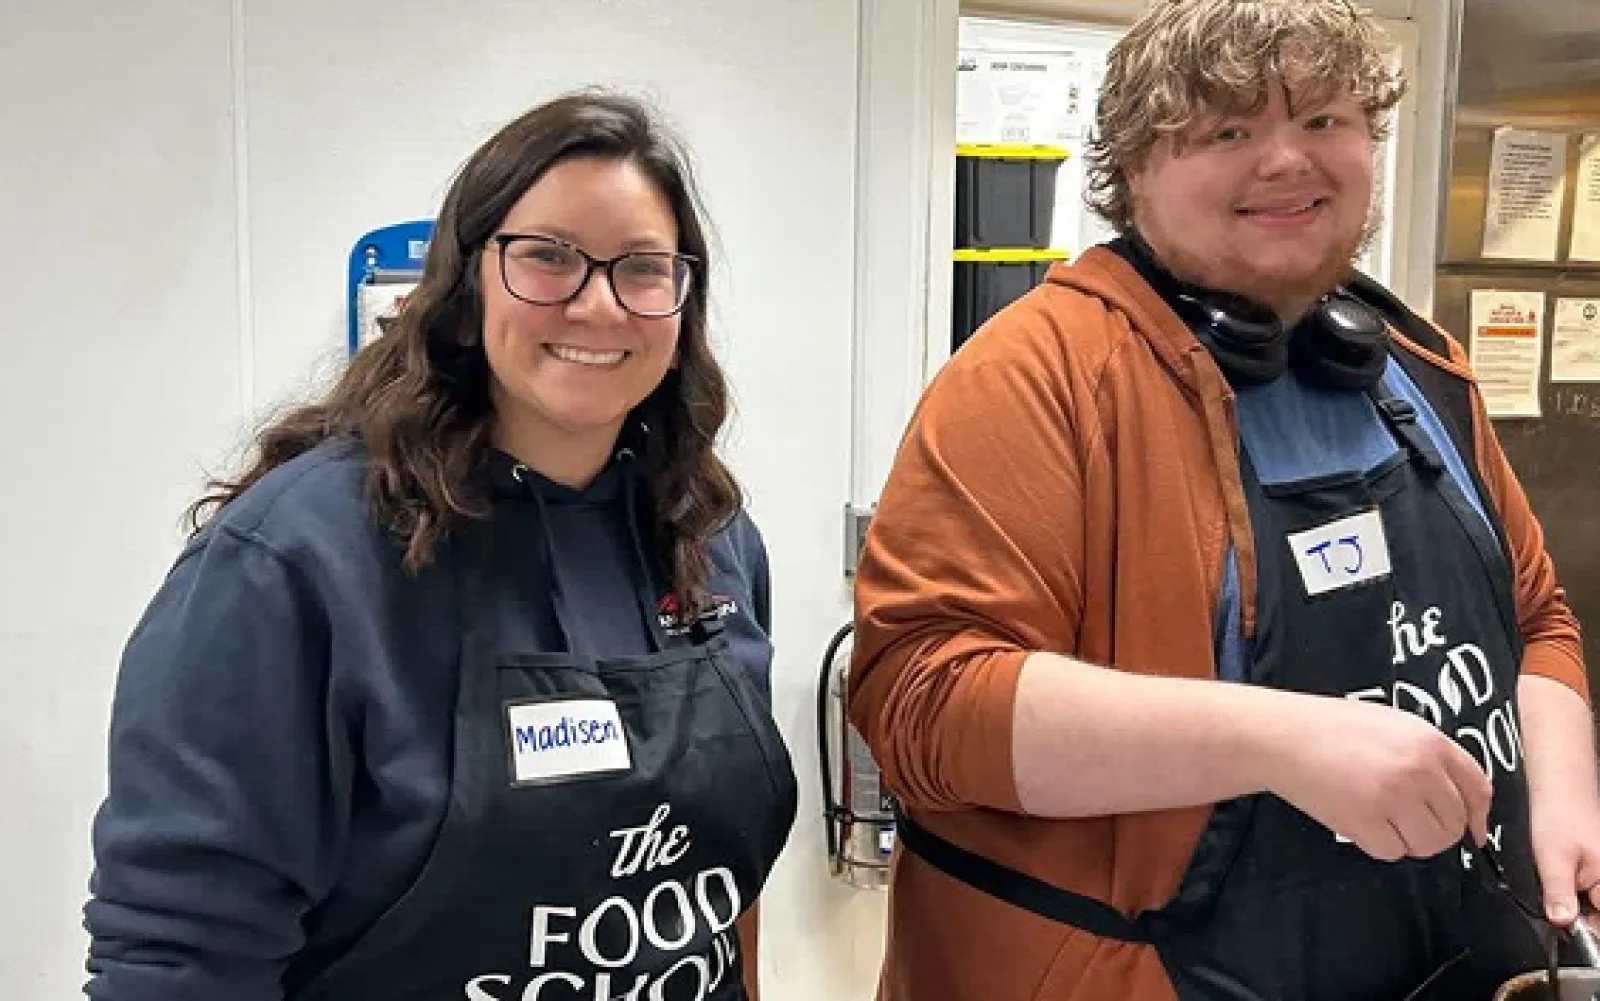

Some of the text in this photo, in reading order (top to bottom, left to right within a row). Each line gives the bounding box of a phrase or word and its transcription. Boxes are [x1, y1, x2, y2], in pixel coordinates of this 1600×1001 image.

[1305, 535, 1364, 574] TJ
[1386, 600, 1447, 664] he
[515, 716, 619, 754] Madisen
[529, 866, 742, 968] FOOD
